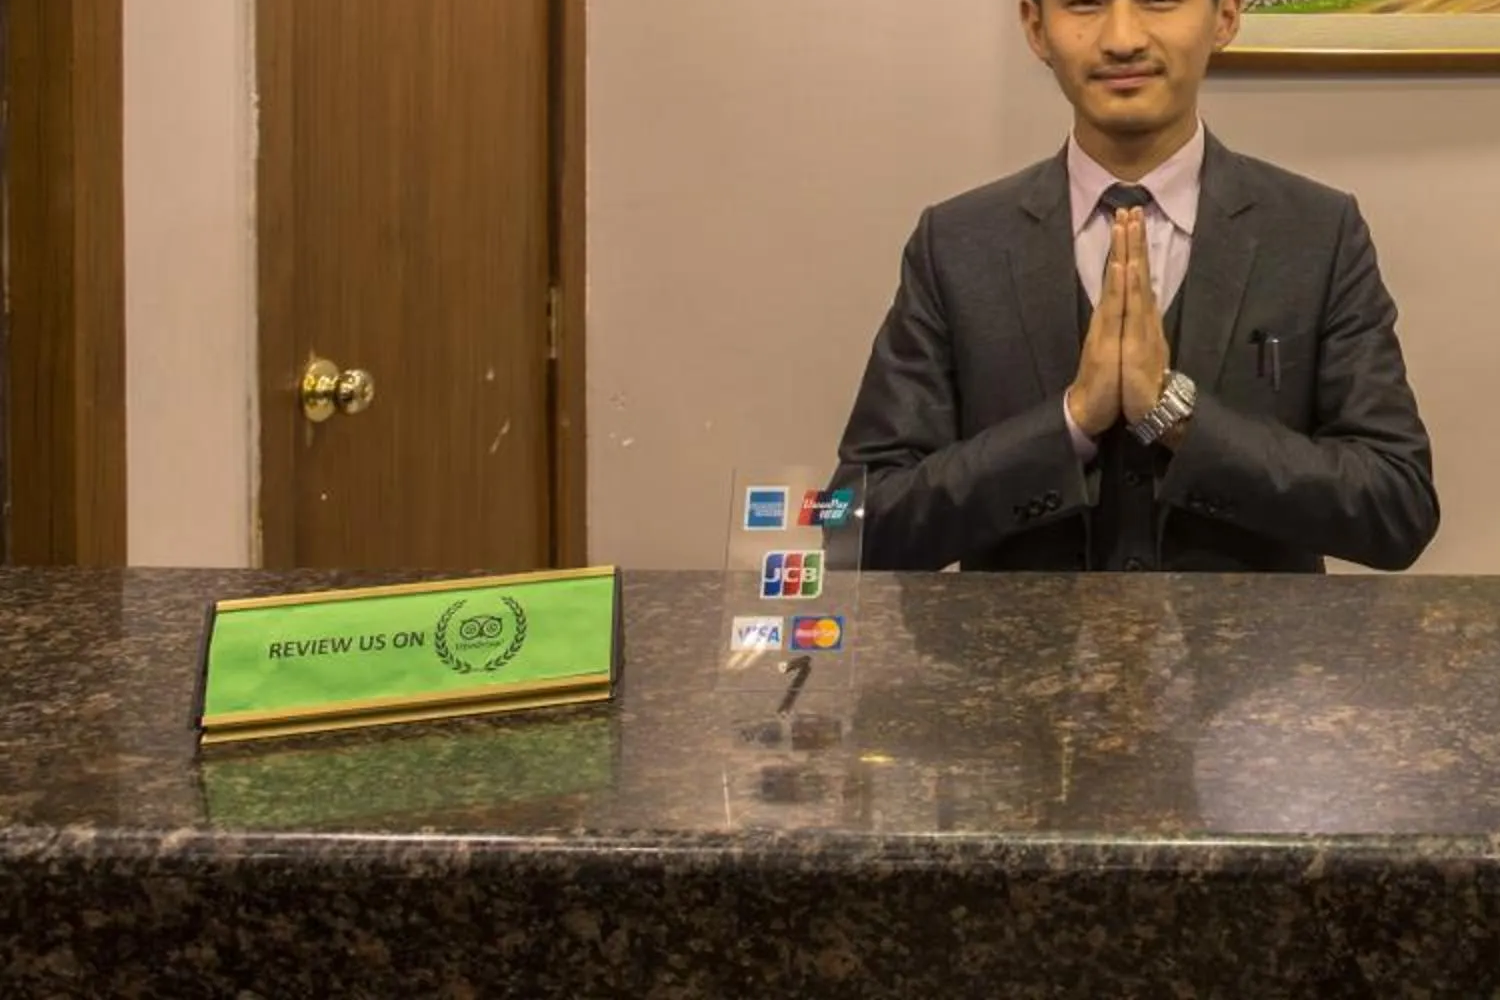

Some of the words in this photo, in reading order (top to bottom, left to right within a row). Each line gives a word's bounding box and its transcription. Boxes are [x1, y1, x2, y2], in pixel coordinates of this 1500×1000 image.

[764, 568, 817, 582] JCB
[268, 638, 352, 659] REVIEW
[359, 634, 386, 651] US
[393, 631, 425, 649] ON
